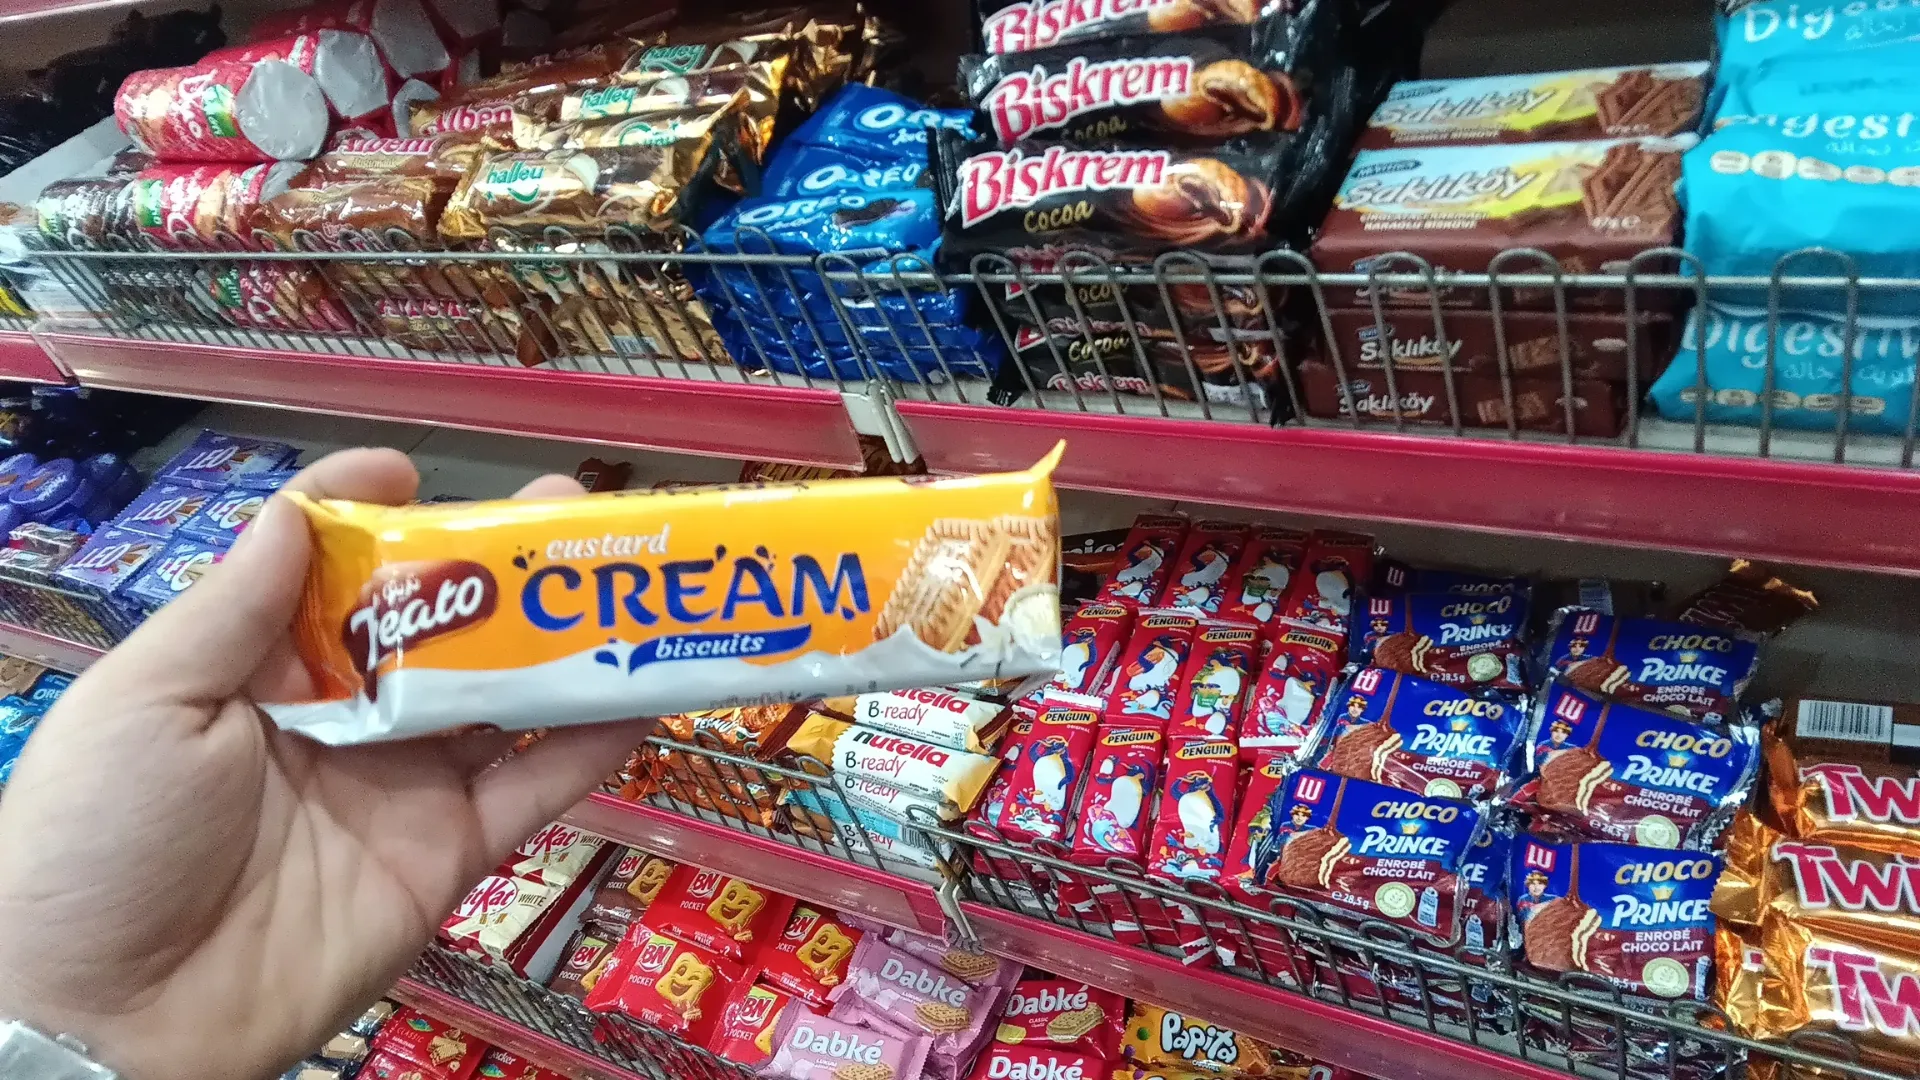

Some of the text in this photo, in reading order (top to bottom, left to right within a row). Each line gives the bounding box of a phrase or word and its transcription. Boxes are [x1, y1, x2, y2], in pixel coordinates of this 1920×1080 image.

[580, 87, 637, 112] halley
[990, 58, 1194, 146] Biskrem
[803, 163, 920, 191] OREO
[960, 147, 1171, 229] Biskrem
[738, 195, 866, 225] OREO
[1024, 199, 1095, 233] Cocoa
[184, 446, 239, 469] LEO
[134, 497, 188, 521] LEO
[545, 523, 671, 560] custard
[80, 543, 131, 569] LEO
[520, 550, 870, 632] CREAM
[1081, 606, 1123, 616] PENGUIN
[1370, 598, 1389, 616] LU
[1440, 595, 1512, 617] CHOCO
[350, 577, 485, 671] Teato
[1573, 614, 1597, 633] LU
[656, 632, 765, 660] biscuits
[1205, 631, 1253, 641] PENGUIN
[1285, 633, 1334, 650] PENGUIN
[1649, 635, 1732, 652] CHOCO
[1638, 657, 1727, 686] PRINCE
[890, 688, 970, 714] utella
[1423, 698, 1503, 721] CHOCO
[1556, 694, 1584, 722] LU
[1643, 692, 1716, 706] CHOCO LAIT
[868, 700, 929, 726] B-ready
[1045, 712, 1092, 722] PENGUIN
[853, 731, 950, 768] nutella
[1107, 732, 1155, 744] PENGUIN
[1410, 724, 1496, 758] PRINCE
[1636, 730, 1732, 758] CHOCO
[1181, 745, 1232, 758] PENGUIN
[845, 751, 907, 778] B-ready
[1412, 762, 1482, 780] CHOCO LAIT
[1621, 754, 1720, 795] PRINCE
[1296, 777, 1322, 801] LU
[1371, 800, 1459, 824] CHOCO
[1623, 795, 1702, 819] CHOCO LAIT
[1360, 826, 1449, 856] PRINCE
[618, 854, 640, 873] BN
[1377, 857, 1426, 871] ENROBÉ
[1527, 844, 1553, 868] LU
[691, 870, 721, 891] BN
[1362, 867, 1435, 881] CHOCO LAIT
[1614, 859, 1713, 885] CHOCO
[453, 877, 547, 917] itKat WHITE
[606, 880, 627, 890] POCKET
[680, 901, 705, 911] POCKET
[1611, 895, 1709, 927] PRINCE
[788, 915, 815, 933] BN
[1635, 927, 1690, 942] ENROBÉ
[574, 945, 603, 964] BN
[641, 943, 672, 966] BN
[1621, 940, 1703, 953] CHOCO LAIT
[559, 970, 582, 981] POCKET
[628, 974, 655, 987] POCKET
[880, 958, 970, 1008] Dabké
[741, 997, 772, 1020] BN
[1004, 984, 1089, 1018] Dabké
[396, 1028, 424, 1042] CLASSIC
[729, 1028, 754, 1041] POCKET
[791, 1026, 885, 1066] Dabké
[1161, 1012, 1239, 1064] Papita
[988, 1056, 1084, 1080] Dabké
